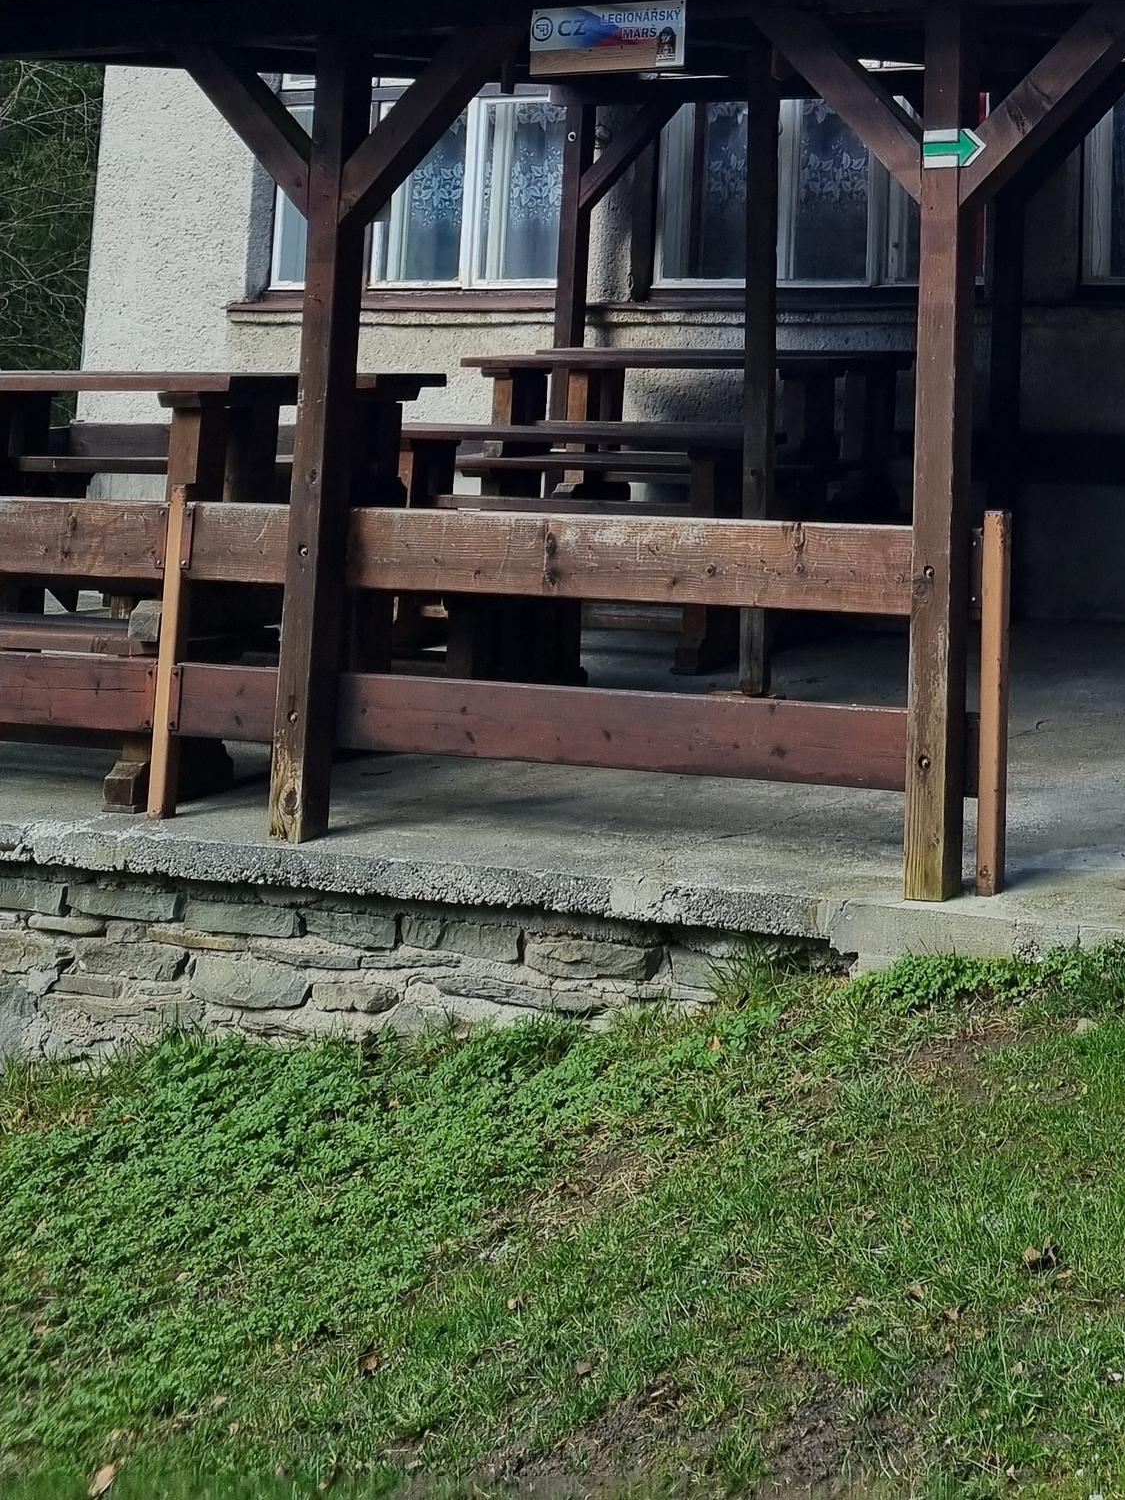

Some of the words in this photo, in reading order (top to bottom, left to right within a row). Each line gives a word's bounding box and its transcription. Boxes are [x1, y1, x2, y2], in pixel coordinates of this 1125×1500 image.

[600, 7, 681, 25] LEGIONÁŘSKÝ
[557, 19, 586, 37] CZ
[622, 24, 657, 40] MARŠ
